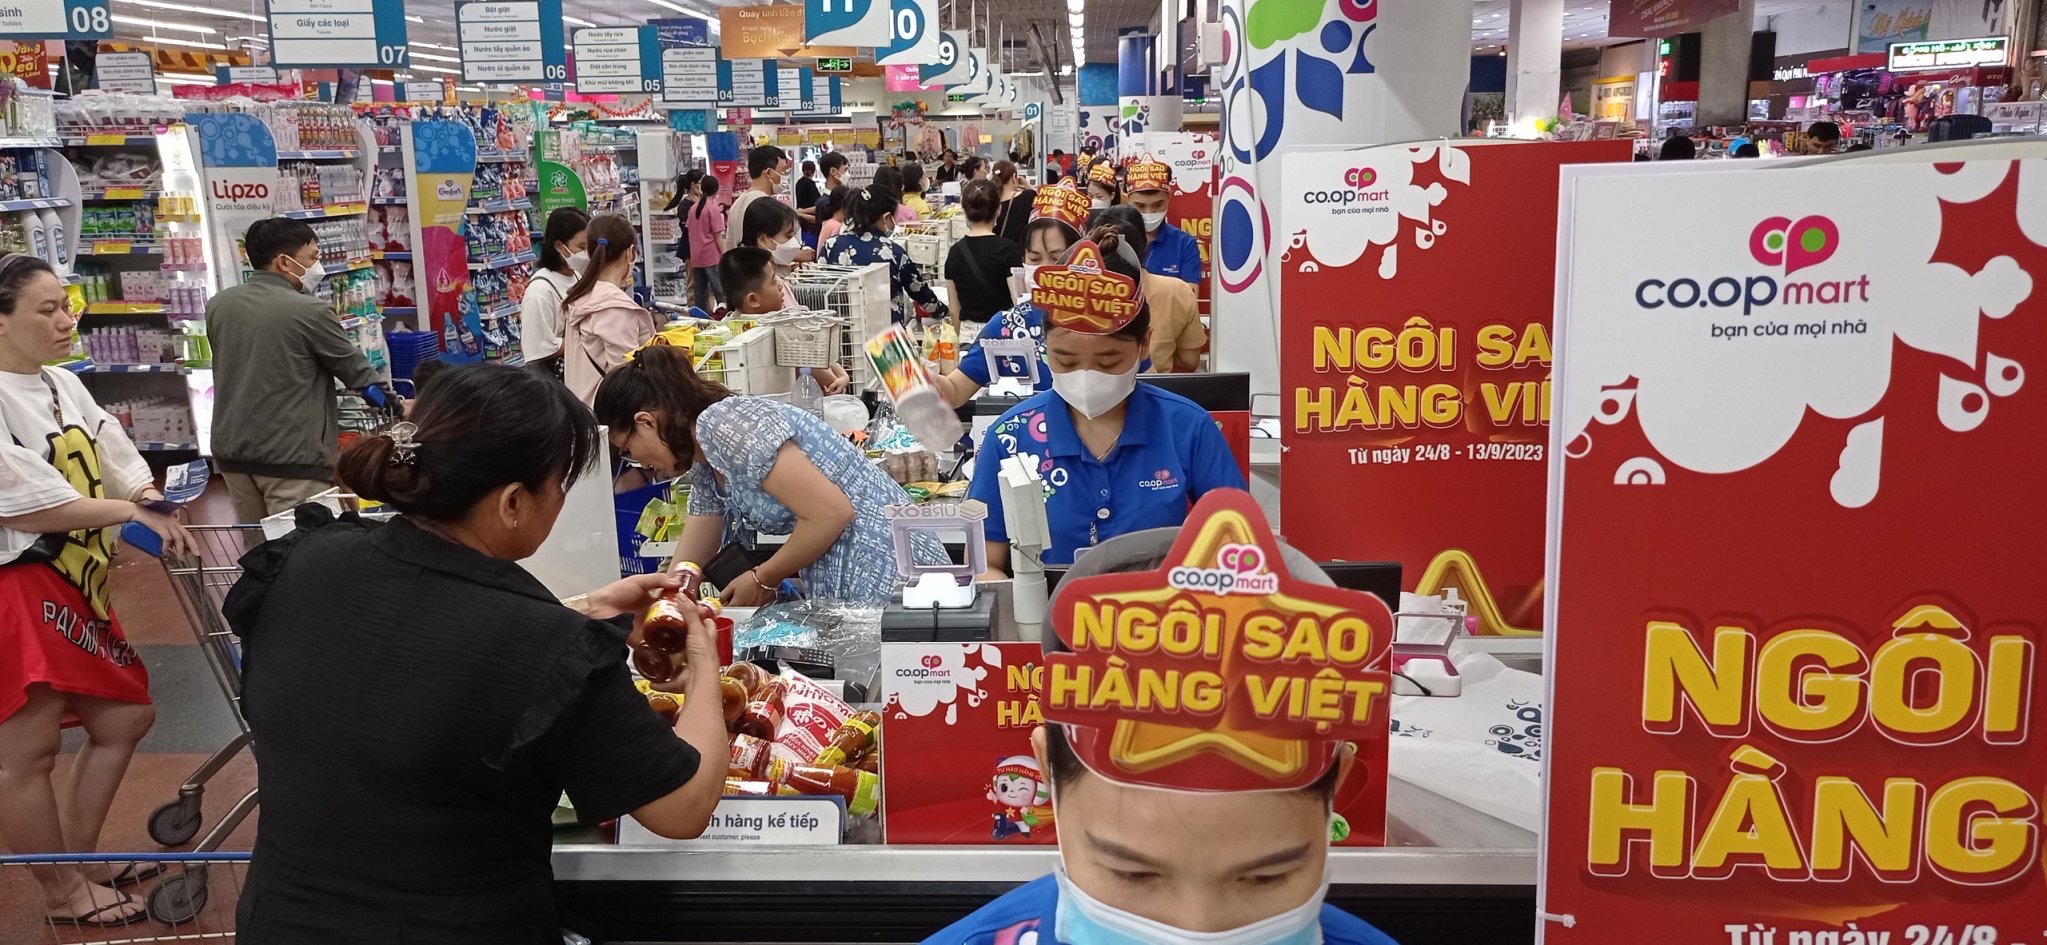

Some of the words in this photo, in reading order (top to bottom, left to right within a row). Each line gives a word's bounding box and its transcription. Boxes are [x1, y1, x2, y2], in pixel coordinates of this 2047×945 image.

[72, 6, 109, 33] 08
[296, 17, 316, 28] Giấy
[317, 18, 333, 27] các
[334, 20, 350, 28] loại
[381, 46, 406, 64] 07
[494, 44, 504, 53] tẩy
[505, 45, 521, 53] quần
[546, 66, 566, 79] 06
[644, 80, 660, 92] 05
[720, 90, 732, 100] 04
[766, 96, 778, 105] 03
[802, 101, 813, 109] 02
[1026, 106, 1039, 116] 01
[212, 180, 268, 202] Lipzo
[438, 188, 462, 196] Comfort
[1040, 188, 1066, 198] NGÔI
[1068, 194, 1089, 207] SAO
[1033, 196, 1064, 206] HÀNG
[1067, 202, 1090, 218] VIỆT
[1038, 272, 1084, 292] NGÔI
[1090, 280, 1130, 298] SAO
[1032, 290, 1086, 308] HÀNG
[1090, 298, 1135, 316] VIỆT
[1710, 323, 1748, 340] bạn
[1754, 321, 1788, 336] của
[1794, 320, 1826, 338] mọi
[1831, 318, 1868, 334] nhà
[1313, 316, 1456, 372] NGÔI
[1295, 375, 1462, 433] HÀNG
[1348, 448, 1368, 465] Từ
[1372, 447, 1410, 465] ngày
[1415, 444, 1450, 462] 24/8
[1466, 443, 1544, 462] 13/9/2023
[1072, 600, 1221, 657] NGÔI
[1243, 616, 1371, 663] SAO
[1642, 604, 2034, 745] NGÔI
[1050, 656, 1224, 711] HÀNG
[1246, 669, 1384, 730] VIỆT
[998, 694, 1045, 728] HÀ
[725, 813, 762, 830] hàng
[768, 812, 786, 828] kế
[790, 812, 818, 831] tiếp
[1588, 744, 2038, 885] HÀNG
